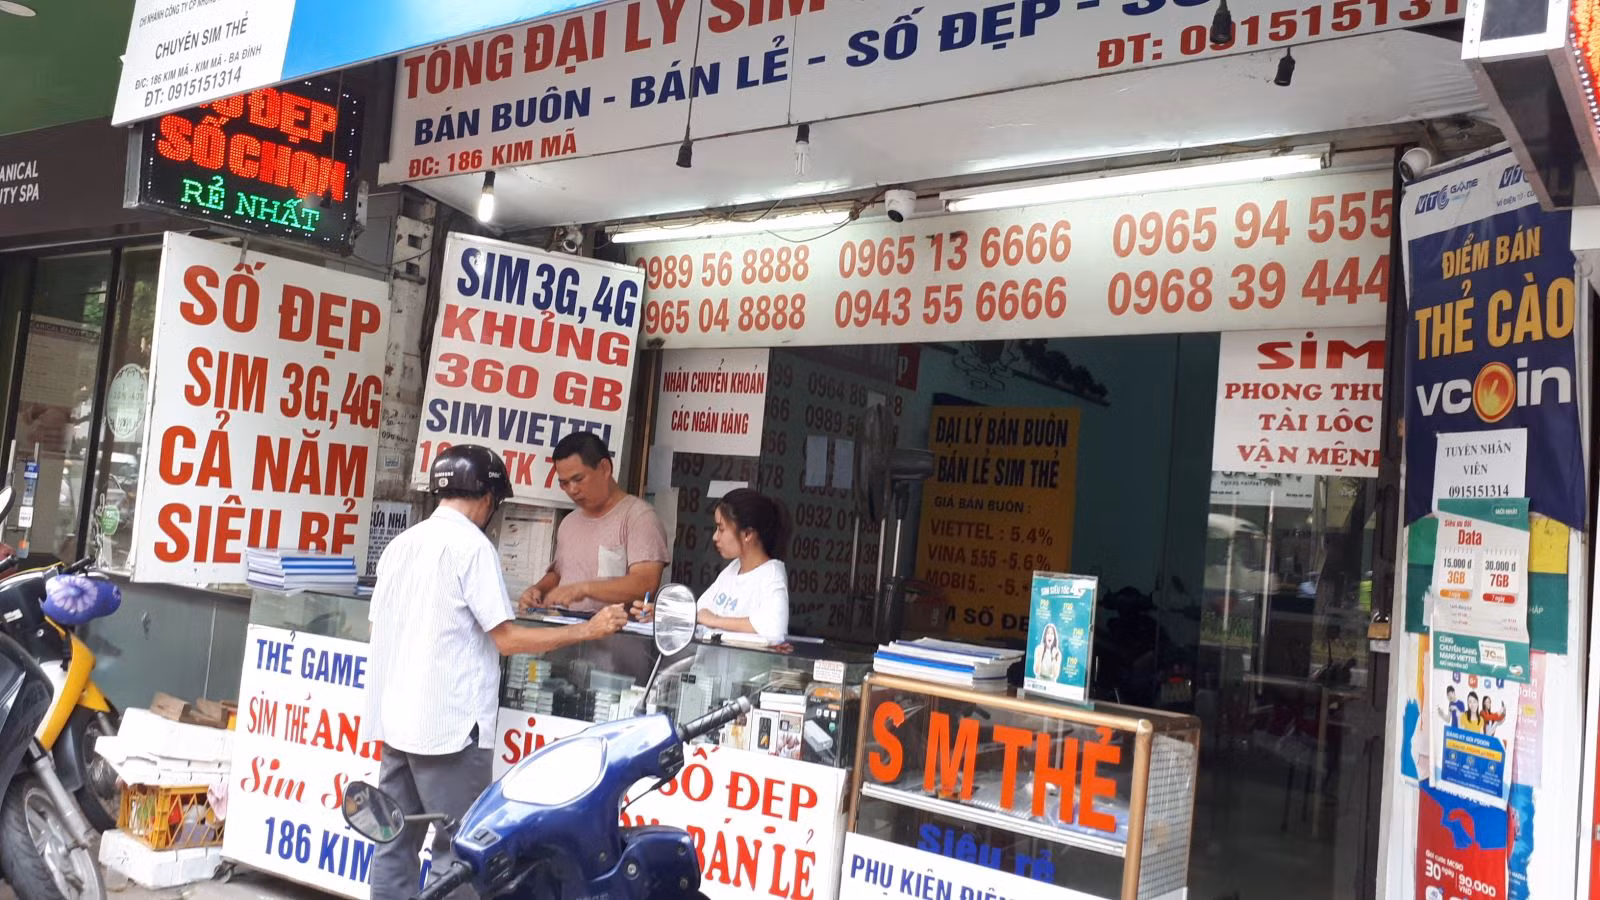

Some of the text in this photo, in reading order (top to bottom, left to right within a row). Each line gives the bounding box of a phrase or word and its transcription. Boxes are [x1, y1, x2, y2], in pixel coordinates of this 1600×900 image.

[155, 10, 249, 60] CHUYÊN SIM THẺ
[523, 9, 607, 75] ĐẠI
[1097, 32, 1163, 69] ĐT:
[144, 65, 242, 108] ĐT: 0915151314
[150, 73, 162, 88] 186
[164, 68, 177, 84] KIM
[195, 60, 210, 75] KIM
[228, 50, 240, 64] BA
[242, 44, 262, 60] ĐÌNH
[414, 0, 1062, 146] BÁN BUÔN BÁN LẺ SỐ ĐẸP
[249, 87, 339, 143] ĐẸP
[158, 115, 347, 202] SỐ CHỌN
[408, 127, 577, 179] ĐC: 186 KIM MÃ
[19, 183, 39, 202] SPA
[181, 175, 321, 232] RẺ NHẤT
[838, 220, 1072, 279] 0965 13 6666
[1112, 206, 1217, 258] 0965
[1233, 200, 1290, 249] 94
[701, 251, 732, 287] 56
[741, 244, 810, 285] 8888
[1441, 224, 1541, 280] ĐIỂM BÁN
[457, 247, 530, 306] SIM
[1107, 266, 1213, 316] 0968
[1228, 261, 1286, 310] 39
[179, 262, 381, 360] SỐ ĐẸP
[699, 297, 730, 334] 04
[738, 293, 806, 332] 8888
[835, 276, 1067, 329] 0943 55 6666
[1415, 271, 1577, 361] THẺ CÀO
[441, 303, 631, 367] KHỦNG
[184, 347, 269, 413] SIM
[434, 353, 622, 412] 360 GB
[663, 357, 765, 398] NHẬN CHUYỂN KHOẢN
[1225, 383, 1322, 401] PHONG
[425, 399, 493, 438] SIM
[671, 404, 749, 435] CÁC NGÂN HÀNG
[935, 411, 1069, 448] ĐẠI LÝ BÁN BUÔN
[1259, 407, 1309, 431] TÀI
[158, 410, 369, 498] CẢ NĂM
[937, 448, 1060, 489] BÁN LẺ SIM THẺ
[1237, 438, 1299, 468] VẬN
[1463, 461, 1488, 475] VIÊN
[1480, 440, 1512, 455] NHÂN
[934, 494, 1025, 514] GIÁ BÁN BUÔN
[1449, 484, 1509, 499] 0915151314
[154, 494, 282, 564] SIÊU
[930, 518, 1053, 546] VIETTEL 5.4%
[1458, 529, 1482, 546] Data
[928, 543, 966, 565] VINA
[1443, 558, 1466, 569] 15.000
[1485, 560, 1509, 572] 30.000
[1447, 571, 1466, 585] 3GB
[1490, 574, 1509, 588] 7GB
[256, 629, 368, 690] THẺ GAME
[240, 756, 305, 803] Sim
[993, 726, 1122, 833] THẺ
[726, 771, 818, 836] ĐẸP
[265, 816, 312, 864] 186
[769, 828, 816, 900] LẺ
[850, 854, 894, 896] PHỤ
[1425, 859, 1441, 881] 30
[1458, 873, 1497, 898] 90.000
